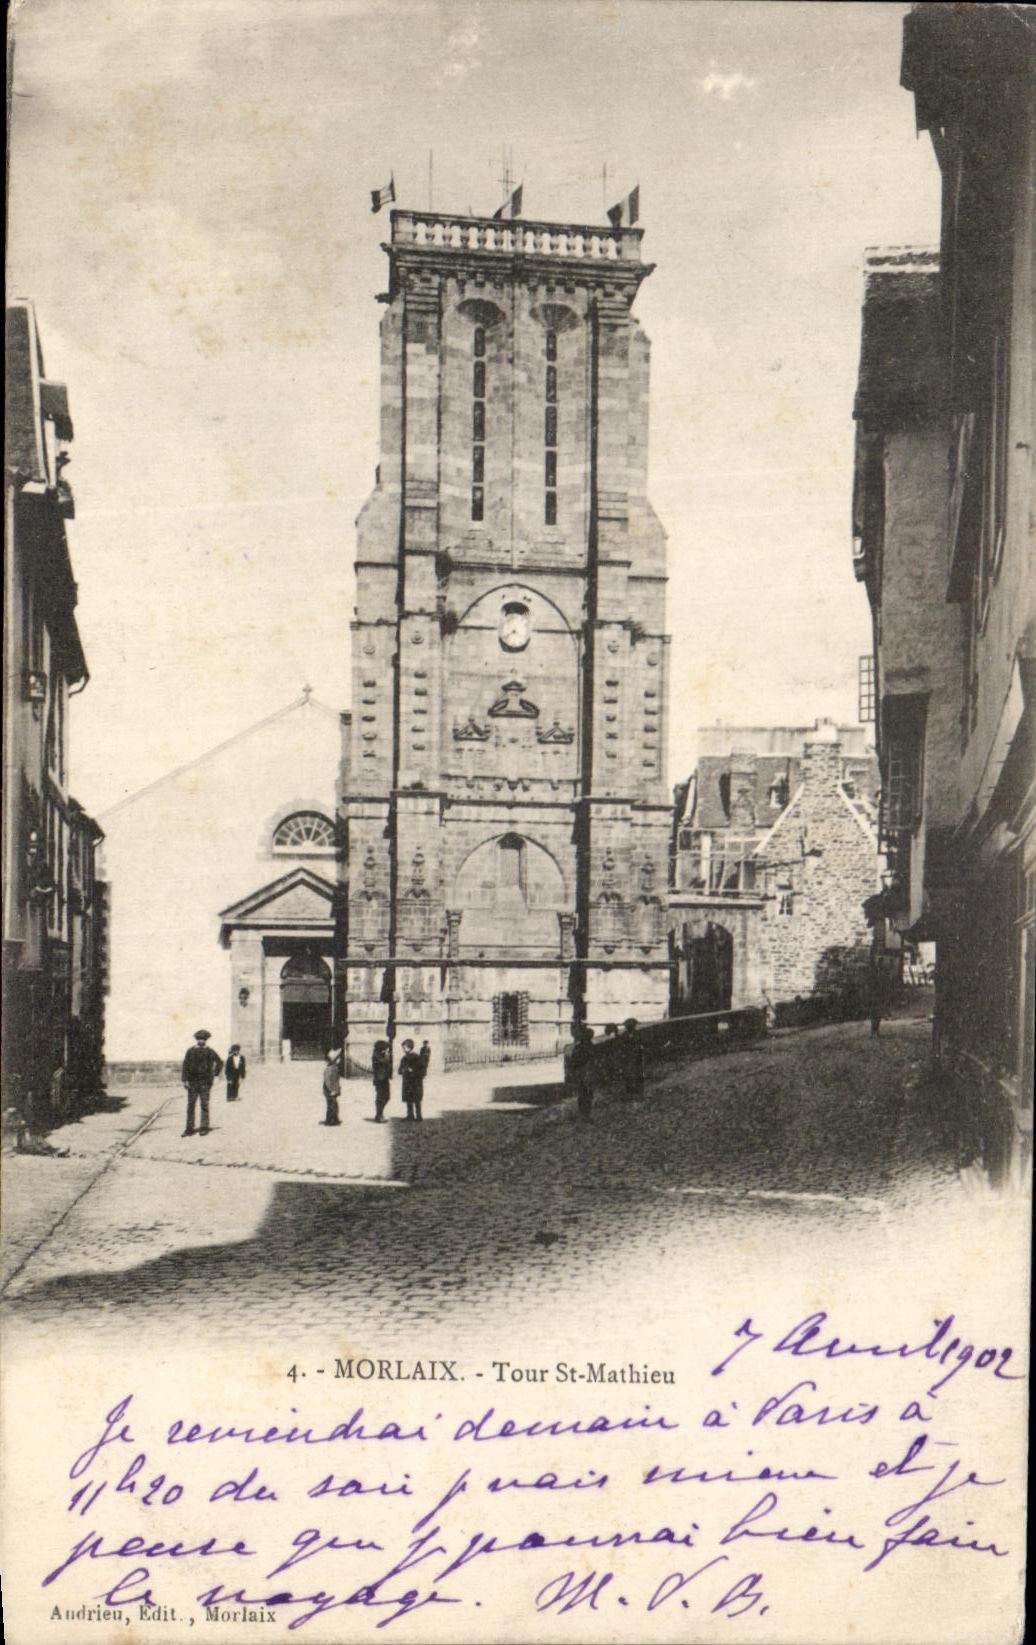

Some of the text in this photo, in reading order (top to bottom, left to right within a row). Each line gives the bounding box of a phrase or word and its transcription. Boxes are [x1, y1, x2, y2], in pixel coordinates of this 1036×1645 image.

[710, 1310, 1026, 1394] 7 Avril 1902
[69, 1394, 135, 1480] Je
[453, 1405, 679, 1444] demain
[702, 1400, 739, 1428] à
[751, 1380, 881, 1427] Paris
[868, 1433, 960, 1480] et
[208, 1467, 279, 1503] du
[884, 1459, 1007, 1528] je
[719, 1491, 866, 1550] bien
